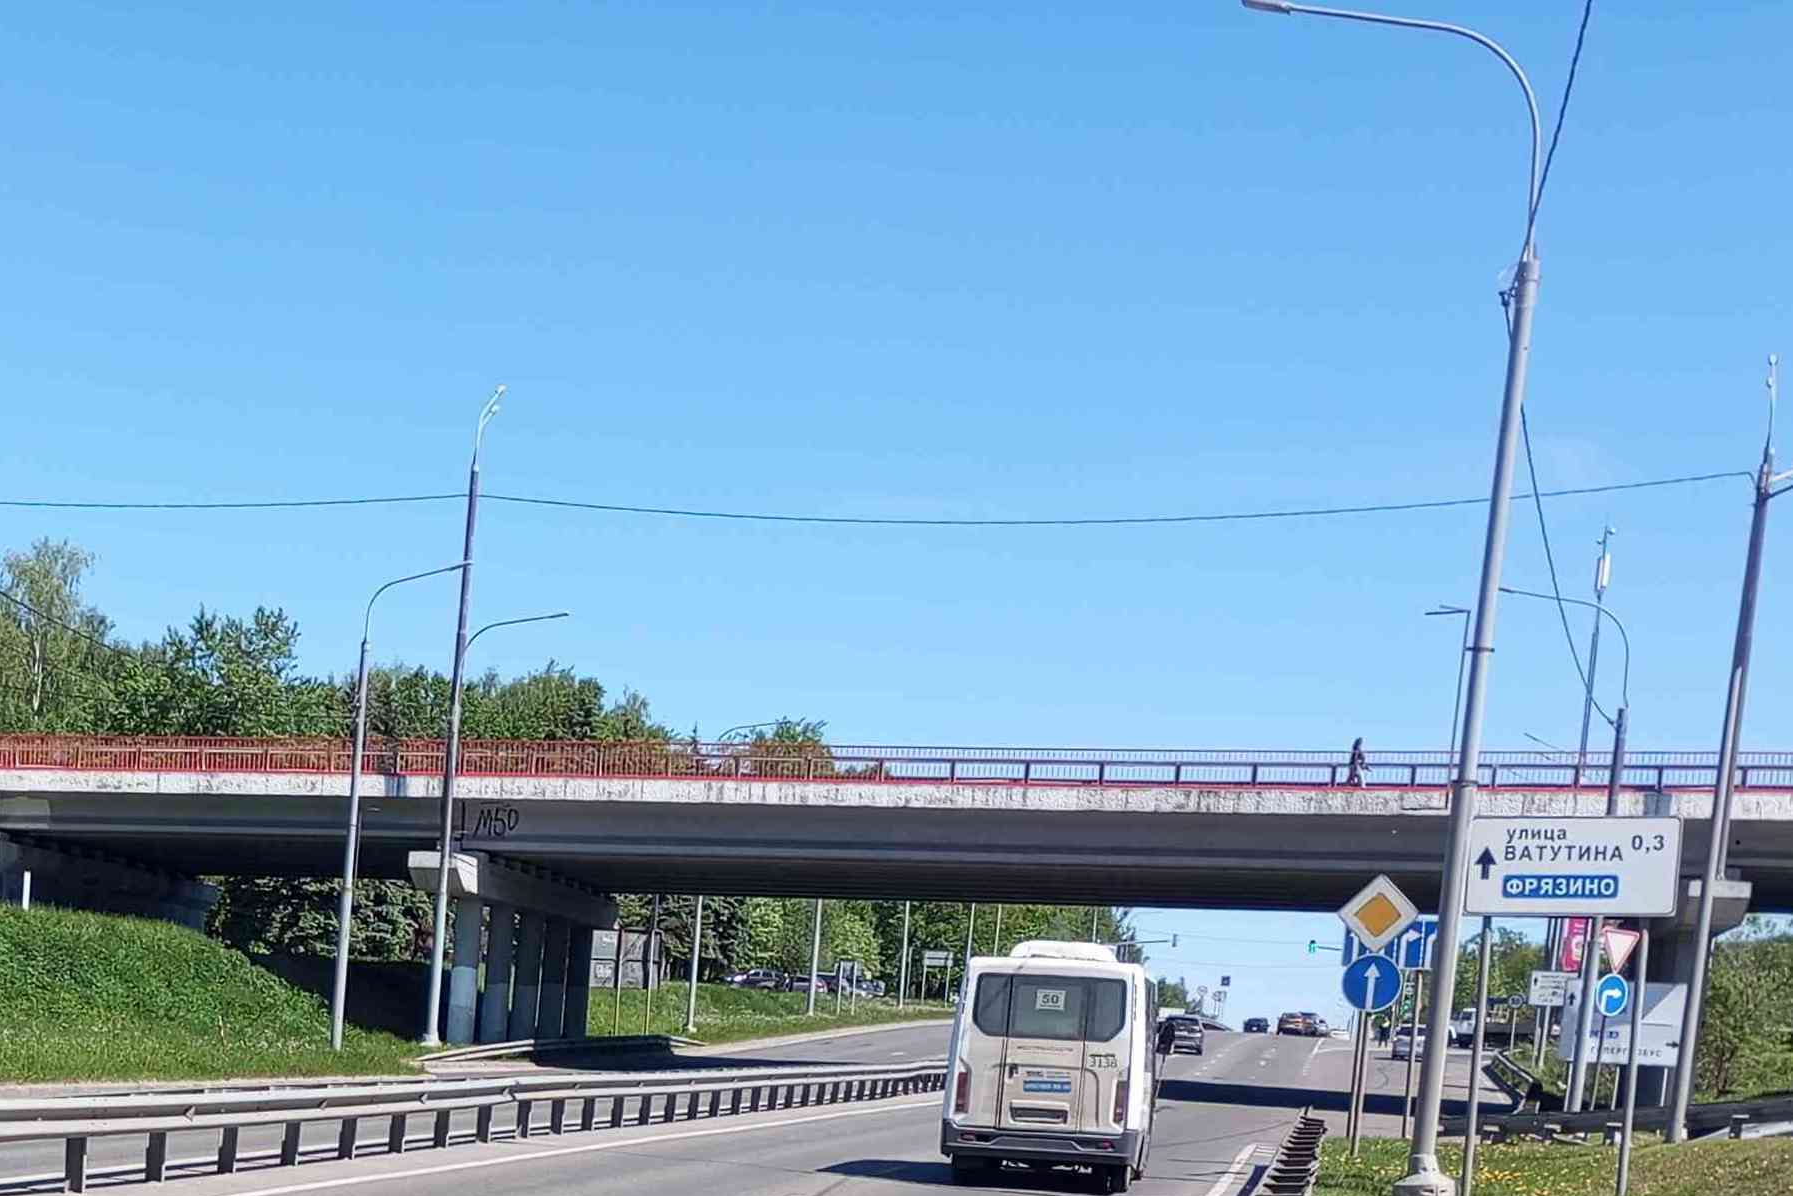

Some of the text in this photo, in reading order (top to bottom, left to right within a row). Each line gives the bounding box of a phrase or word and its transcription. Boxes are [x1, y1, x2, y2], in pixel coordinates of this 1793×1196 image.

[1506, 826, 1568, 844] улица
[1631, 834, 1665, 853] 0,3
[1504, 844, 1625, 862] ВАТУТИНА
[1506, 878, 1615, 896] ФРЯЗИНО
